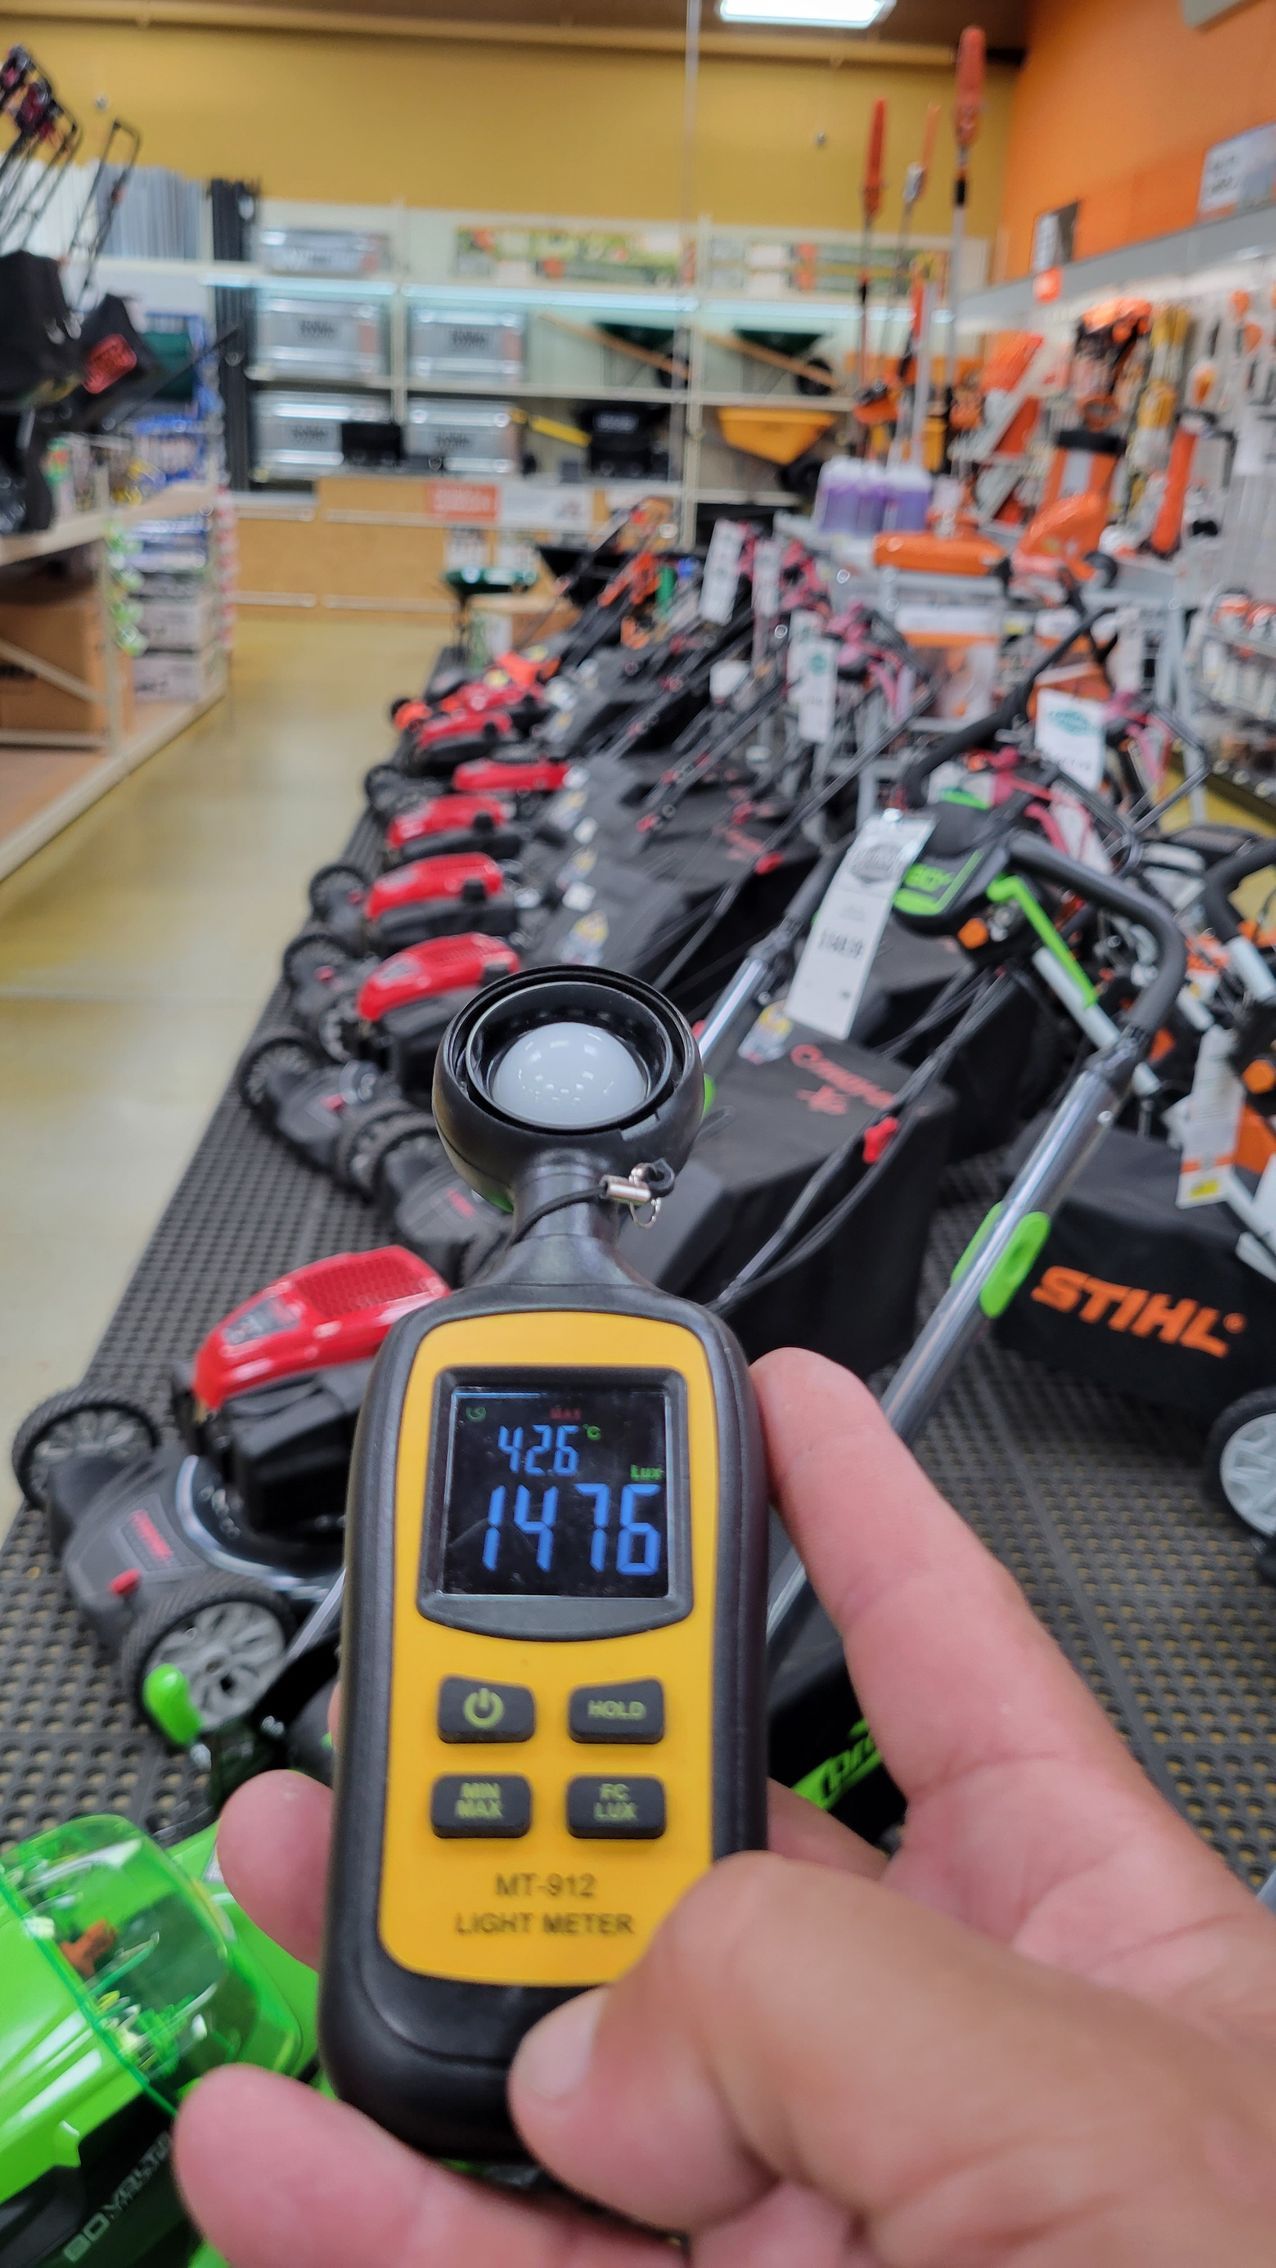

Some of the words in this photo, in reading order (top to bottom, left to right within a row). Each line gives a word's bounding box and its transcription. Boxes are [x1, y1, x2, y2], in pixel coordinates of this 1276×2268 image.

[481, 1483, 662, 1576] 1476
[587, 1699, 646, 1721] HOLD
[459, 1782, 502, 1799] MIN
[455, 1799, 503, 1819] MAX
[593, 1802, 637, 1821] LUX
[495, 1874, 597, 1898] MT-912
[455, 1912, 532, 1936] LIGHT
[543, 1912, 635, 1935] METER
